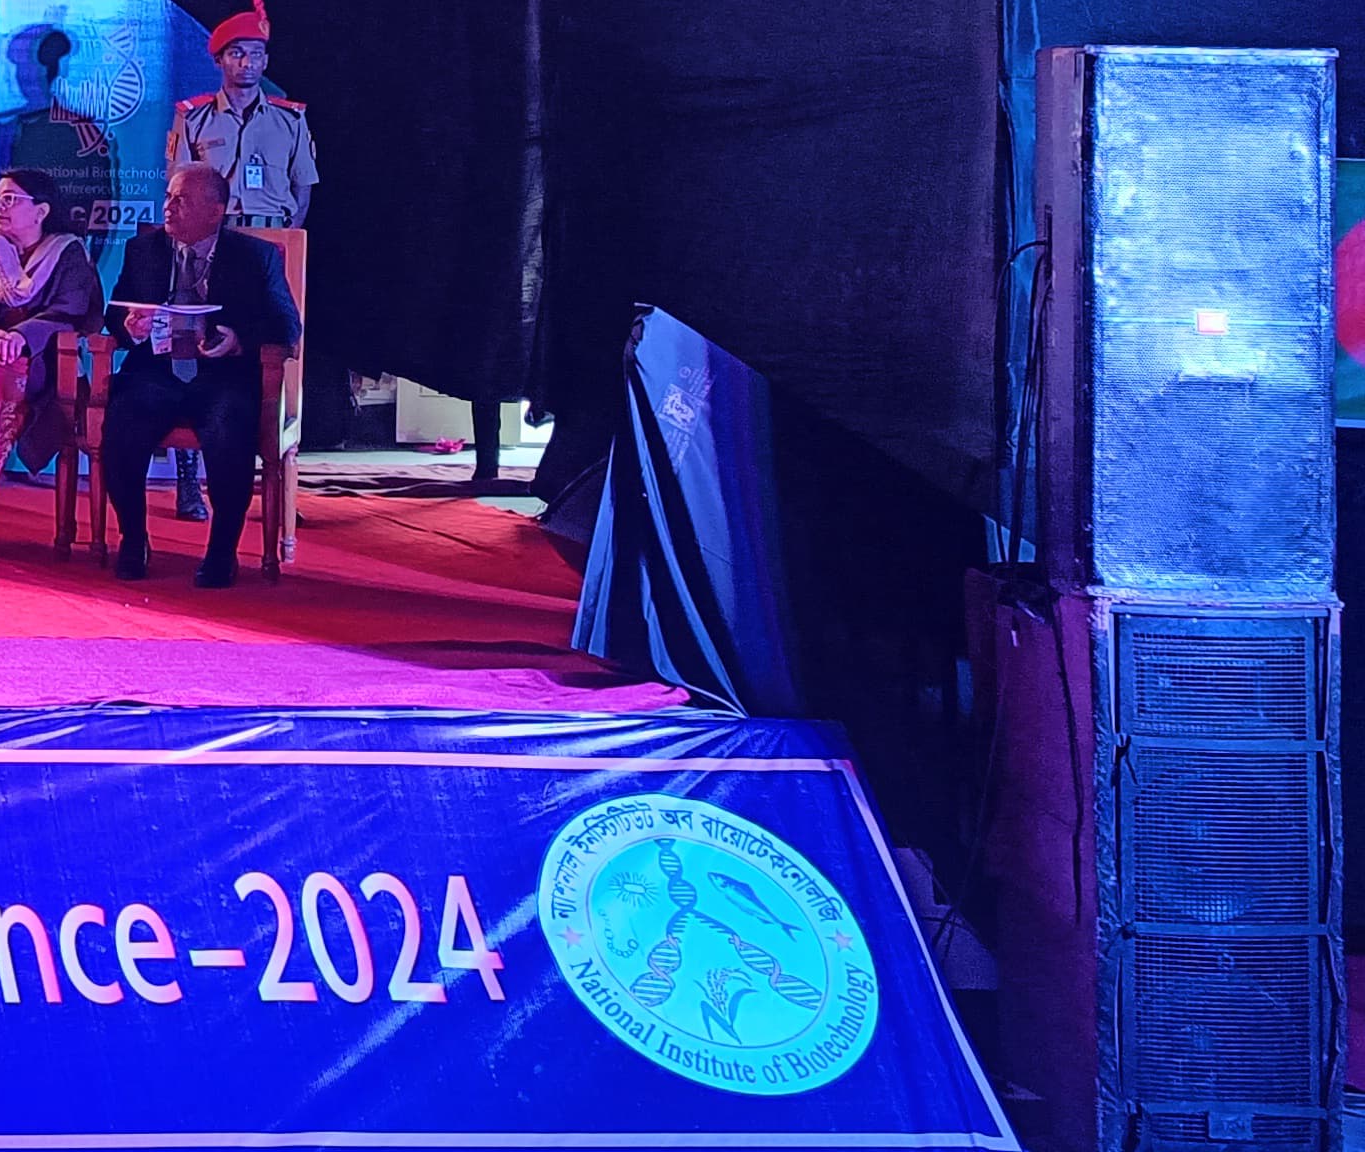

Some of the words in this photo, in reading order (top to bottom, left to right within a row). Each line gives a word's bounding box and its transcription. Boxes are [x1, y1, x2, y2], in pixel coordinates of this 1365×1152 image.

[92, 167, 167, 180] Biotechnolo
[119, 183, 149, 196] 2024
[92, 206, 152, 225] 2024
[659, 809, 694, 831] অব
[570, 956, 655, 1047] National
[655, 1031, 757, 1085] Institute
[761, 1053, 790, 1086] of
[783, 961, 875, 1080] Biotechnology
